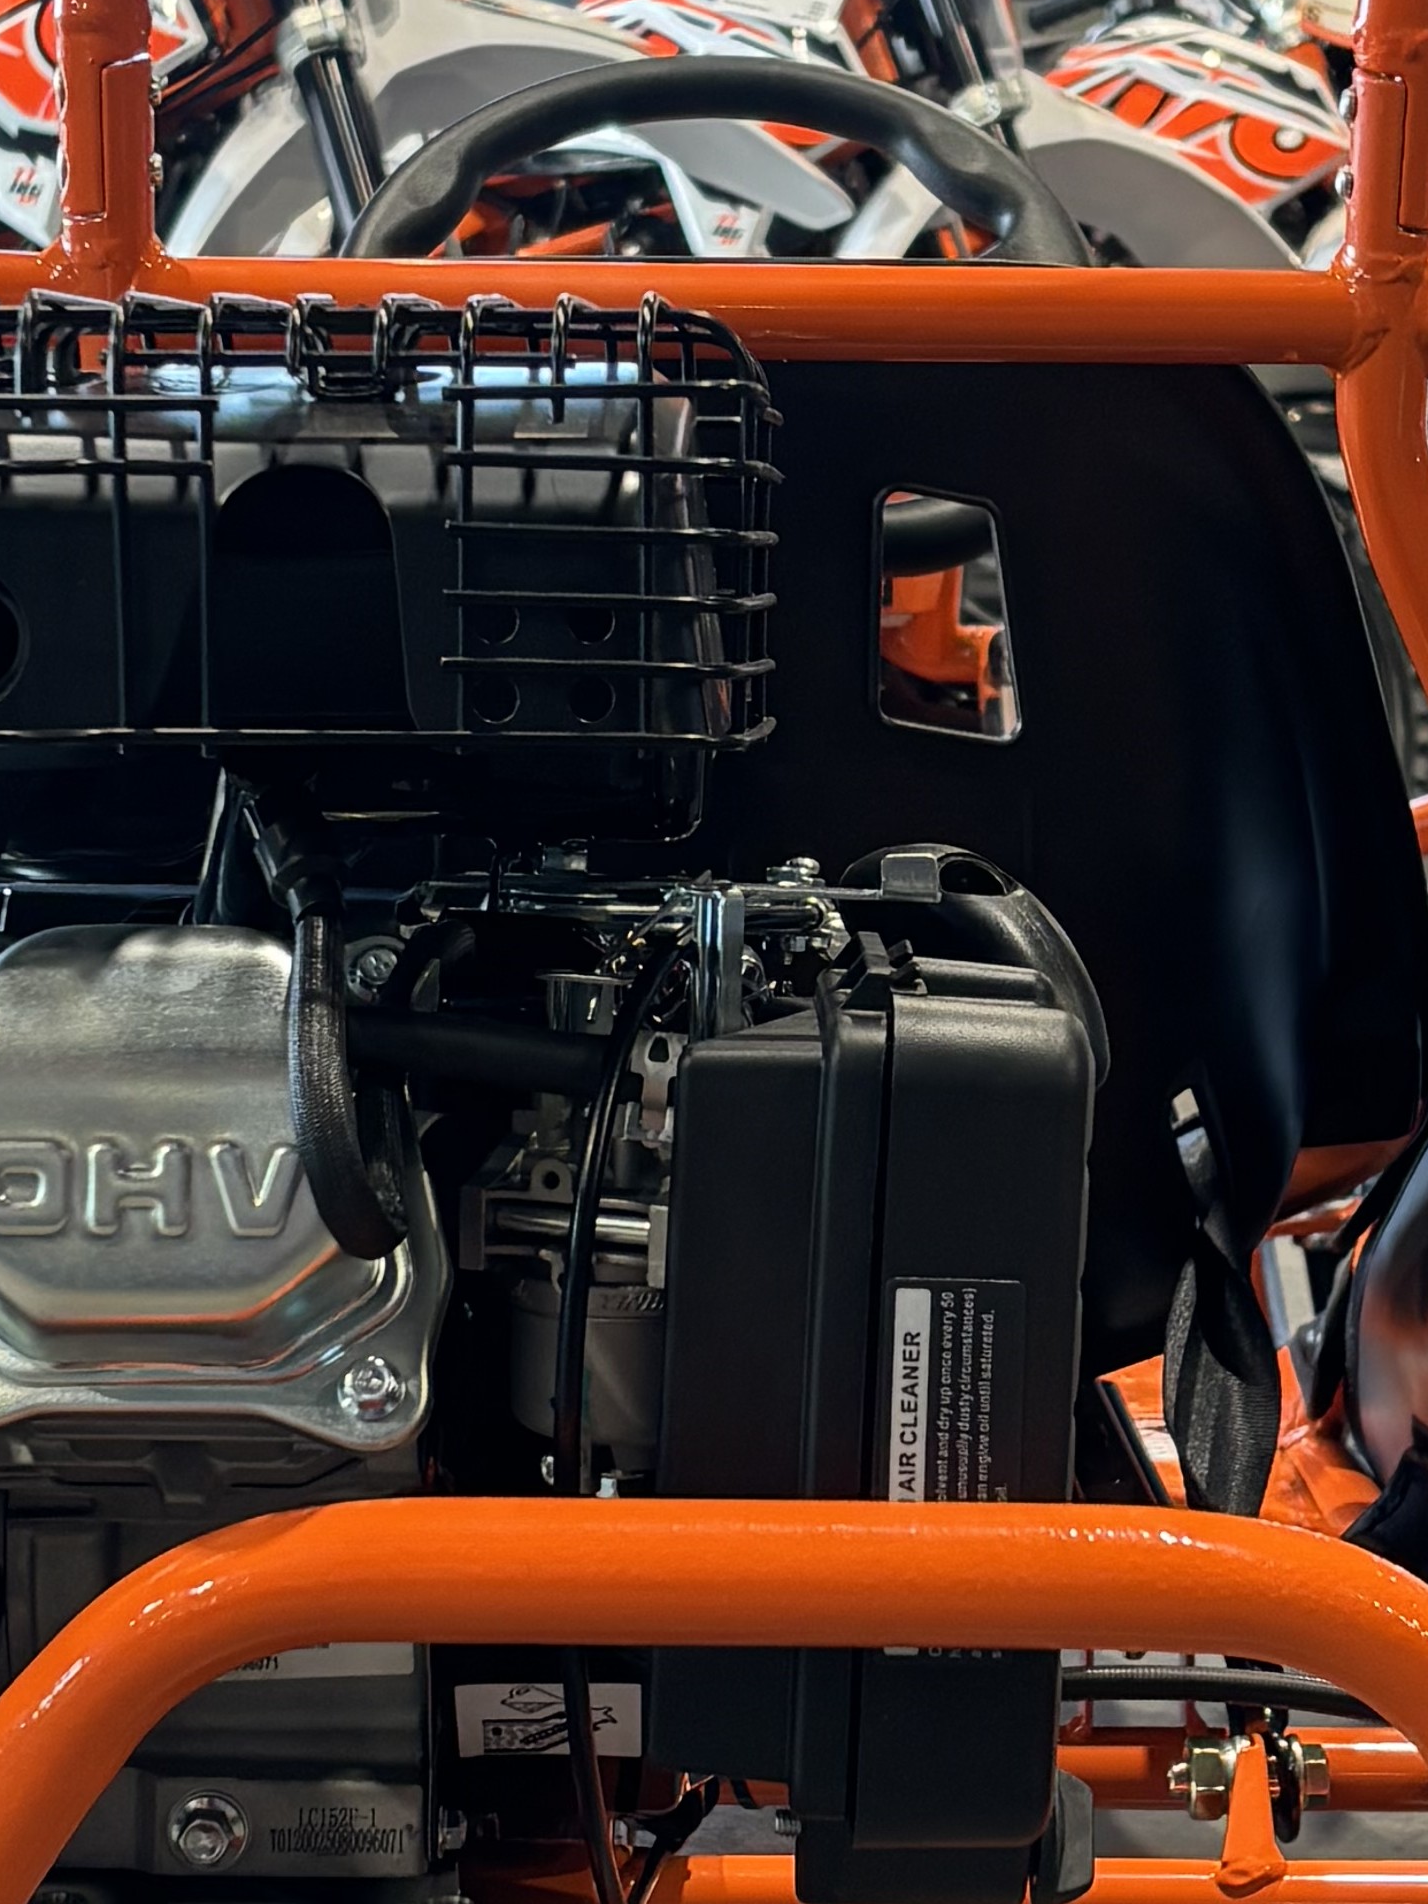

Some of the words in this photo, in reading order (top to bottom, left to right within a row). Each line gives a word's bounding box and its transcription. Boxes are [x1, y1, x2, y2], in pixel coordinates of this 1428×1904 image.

[942, 1310, 957, 1349] every
[959, 1287, 977, 1391] circumstances)
[899, 1330, 923, 1446] CLEANER
[940, 1386, 954, 1405] up
[936, 1407, 954, 1430] dry
[957, 1392, 975, 1431] dusty
[936, 1432, 950, 1458] and
[898, 1453, 918, 1494] AIR
[935, 1459, 949, 1502] olvent
